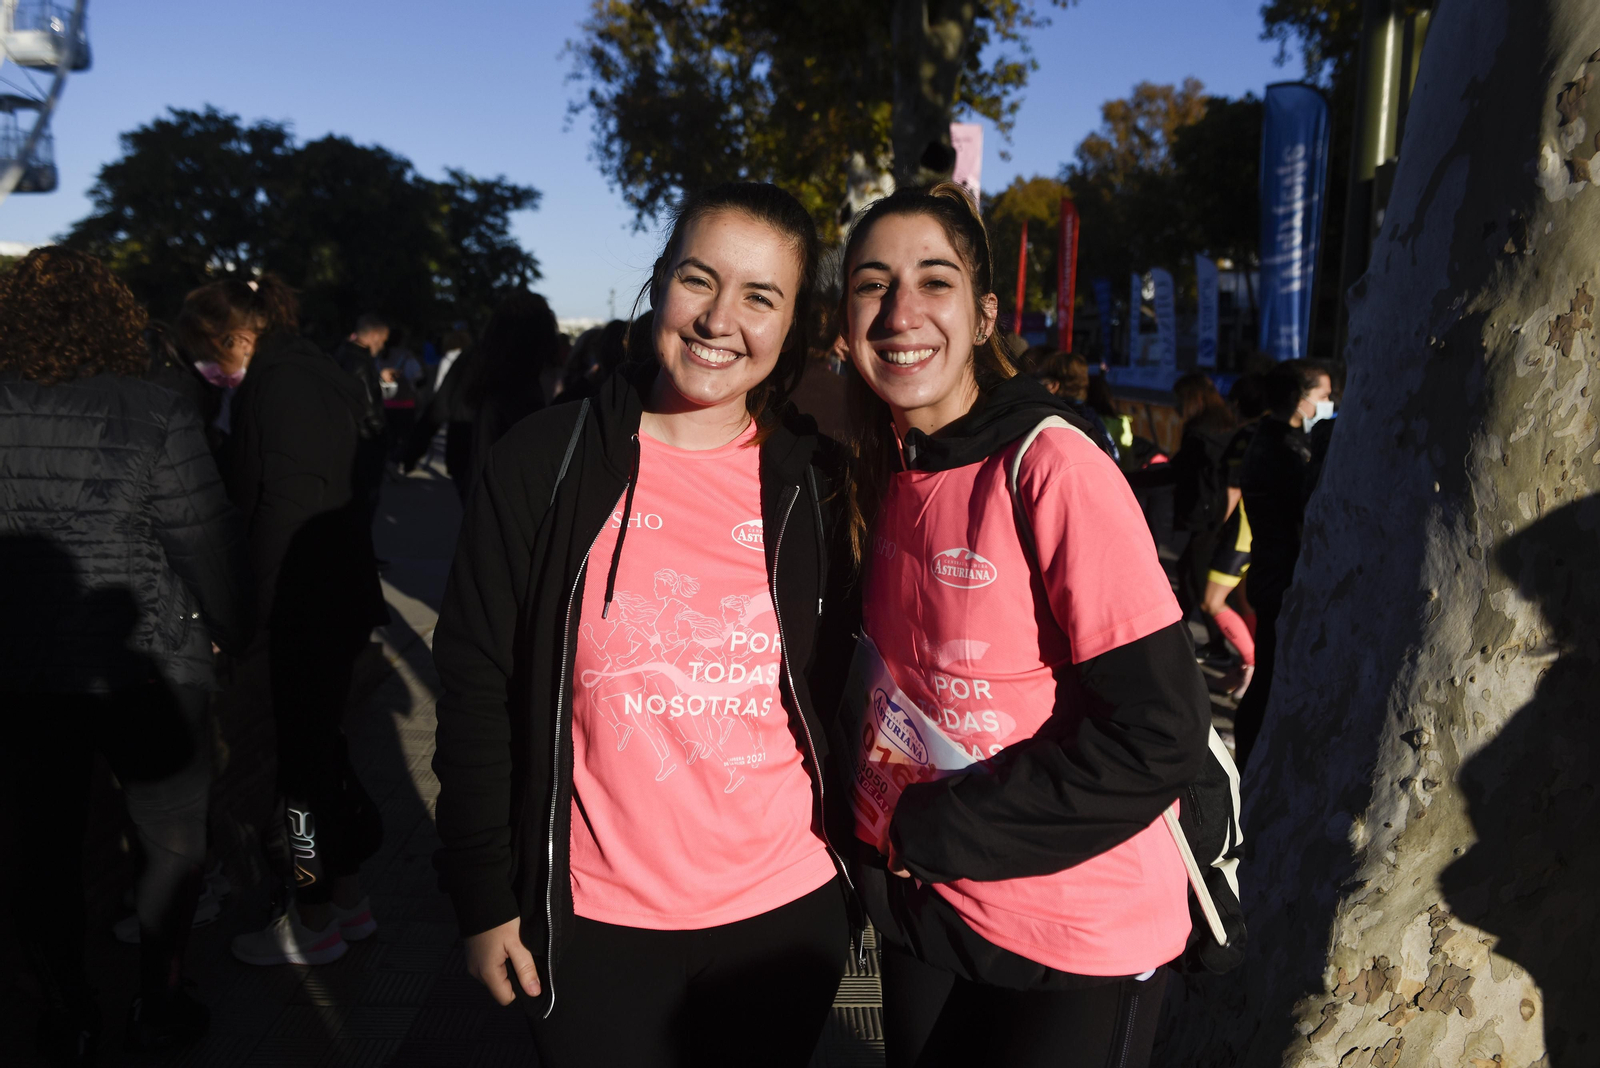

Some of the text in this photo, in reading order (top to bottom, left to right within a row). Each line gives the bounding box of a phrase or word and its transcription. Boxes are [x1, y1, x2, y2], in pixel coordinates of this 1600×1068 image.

[611, 511, 664, 530] SHO
[935, 559, 991, 581] ASTURIANA
[730, 631, 782, 653] POR
[688, 661, 778, 685] TODAS
[934, 676, 993, 700] POR
[624, 693, 773, 718] NOSOTRAS
[917, 698, 1000, 732] TODAS
[874, 695, 923, 762] ASTURIANA
[746, 752, 767, 764] 2021
[860, 759, 888, 794] 3050
[862, 779, 874, 794] DE
[873, 793, 885, 806] LA
[287, 807, 317, 888] FILA
